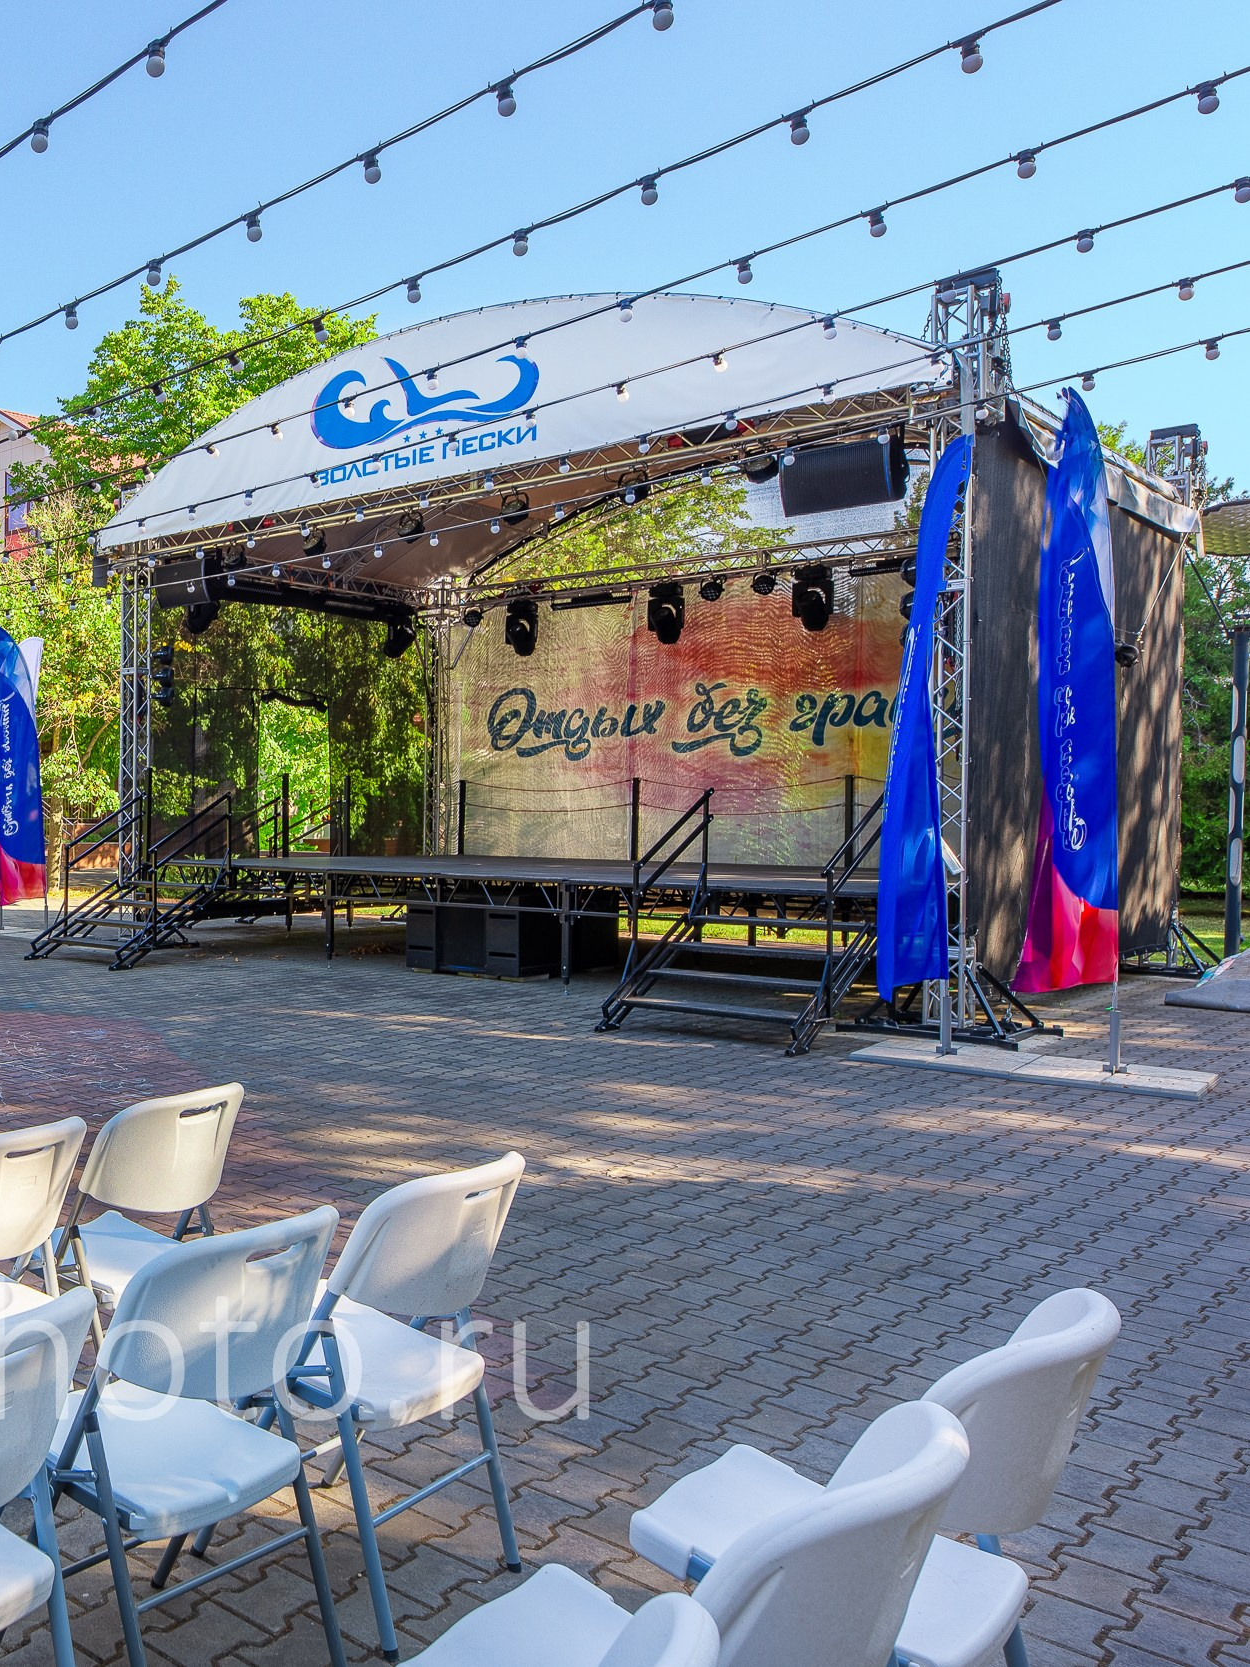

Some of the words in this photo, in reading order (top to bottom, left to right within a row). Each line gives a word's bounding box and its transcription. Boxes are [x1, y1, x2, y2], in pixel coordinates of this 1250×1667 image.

[443, 425, 537, 459] ПЕСКИ
[487, 687, 665, 761] Отдых
[672, 683, 767, 757] без
